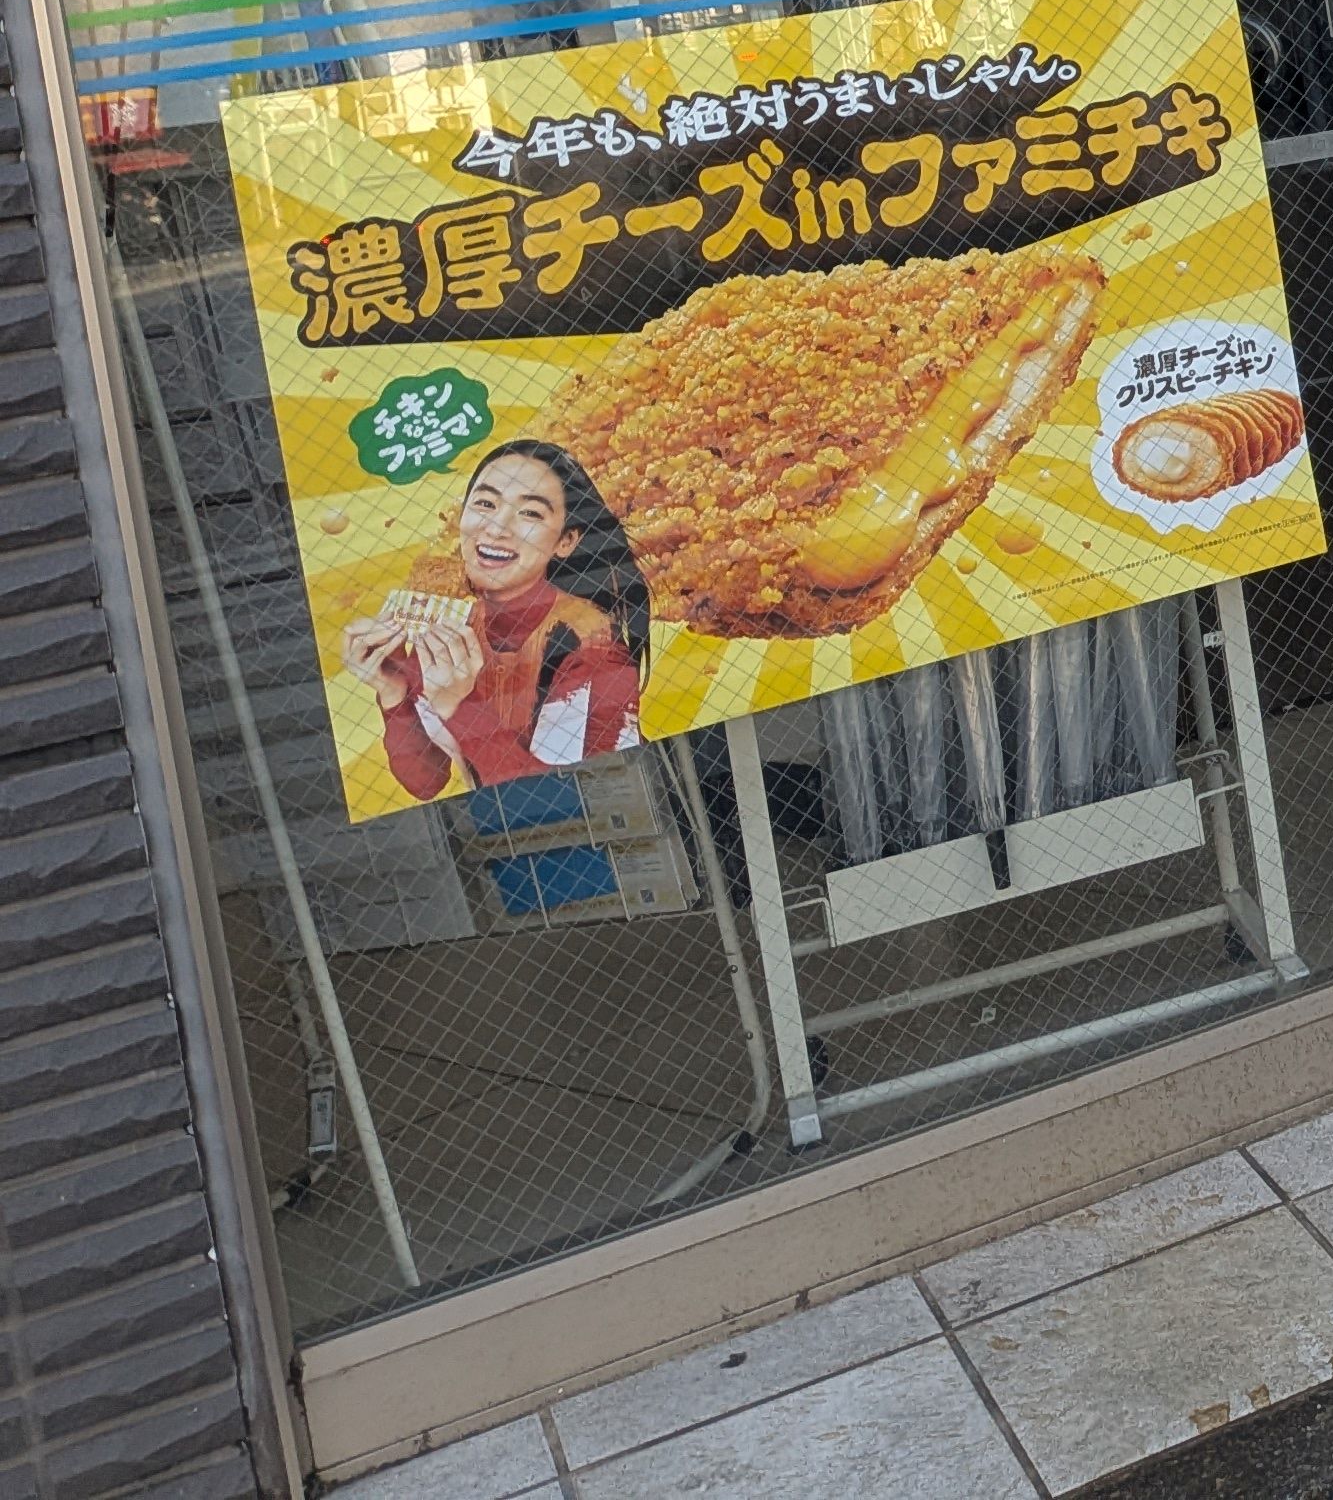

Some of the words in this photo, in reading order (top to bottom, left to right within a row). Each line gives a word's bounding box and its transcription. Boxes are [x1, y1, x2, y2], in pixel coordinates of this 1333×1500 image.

[458, 46, 1078, 178] 今年も、絶対うまいじゃん。
[293, 87, 1227, 342] 濃厚チーズinファミチキ
[1115, 346, 1277, 409] クリスピーチキン
[1132, 333, 1257, 380] 濃厚チーズin
